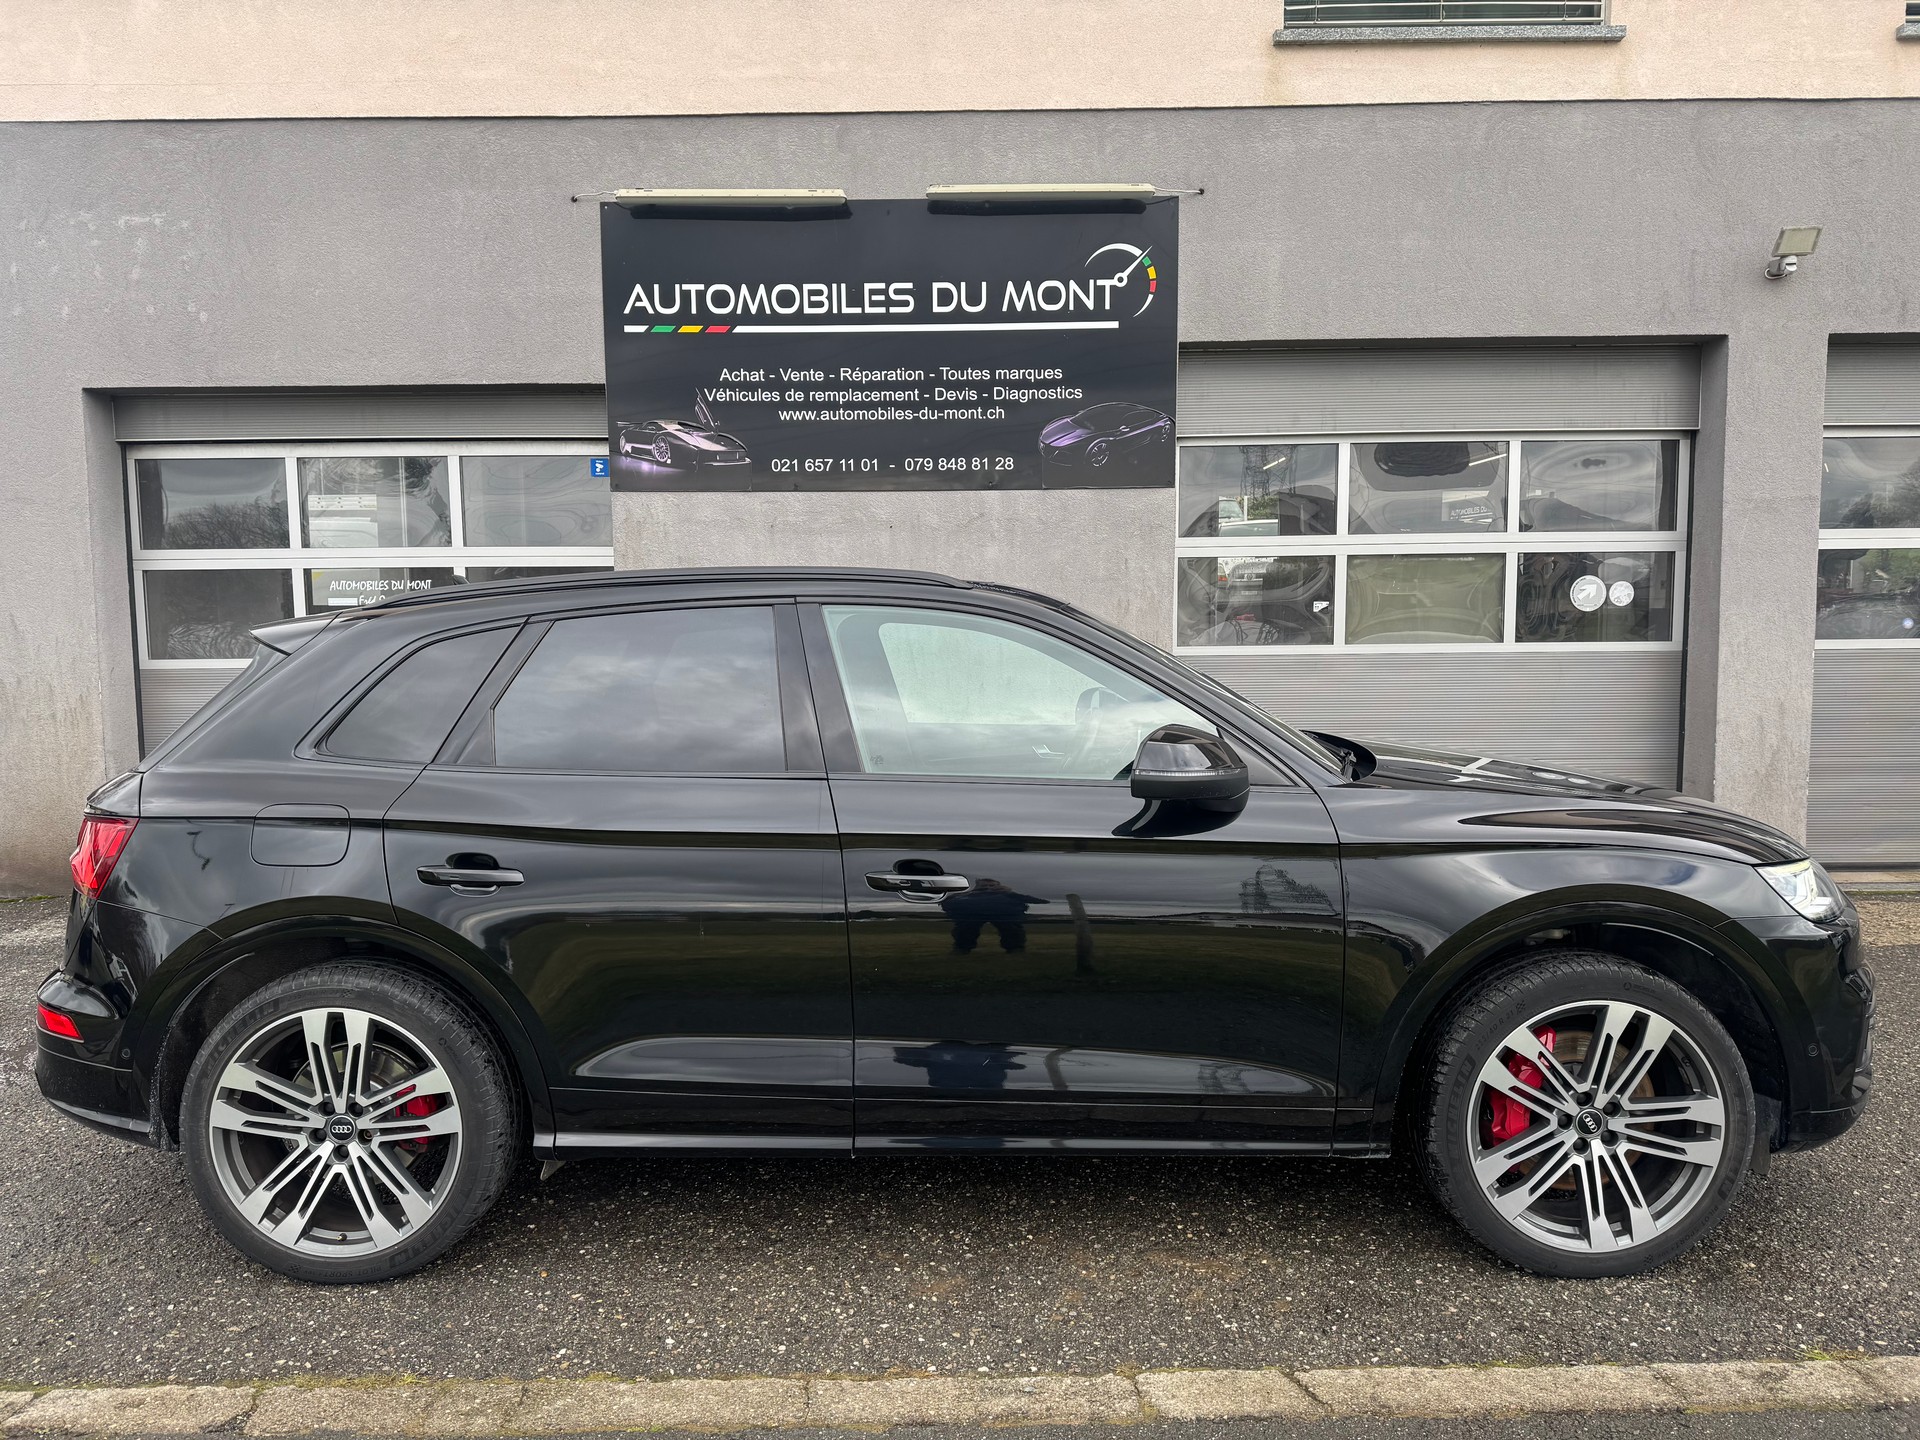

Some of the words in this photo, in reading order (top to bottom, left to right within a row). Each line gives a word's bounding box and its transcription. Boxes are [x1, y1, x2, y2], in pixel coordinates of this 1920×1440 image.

[623, 283, 915, 315] AUTOMOBILES
[932, 281, 987, 313] DU
[1002, 279, 1114, 312] MONT
[719, 368, 765, 382] Achat
[779, 368, 824, 382] Vente
[840, 367, 924, 383] Réparation
[940, 367, 991, 381] Toutes
[995, 367, 1063, 382] marques
[704, 388, 780, 402] Véhicules
[785, 388, 804, 402] de
[809, 387, 919, 404] remplacement
[934, 387, 978, 401] Devis
[993, 386, 1083, 402] Diagnostics
[778, 406, 1005, 421] www.automobiles-du-mont.ch
[771, 458, 798, 472] 021
[804, 458, 834, 472] 657
[839, 458, 855, 472] 11
[860, 458, 878, 472] 01
[904, 457, 933, 471] 079
[938, 457, 967, 471] 848
[971, 457, 988, 471] 81
[994, 457, 1014, 470] 28
[329, 580, 389, 591] AUTOMOBILES
[391, 580, 404, 590] DU
[406, 580, 432, 590] MONT
